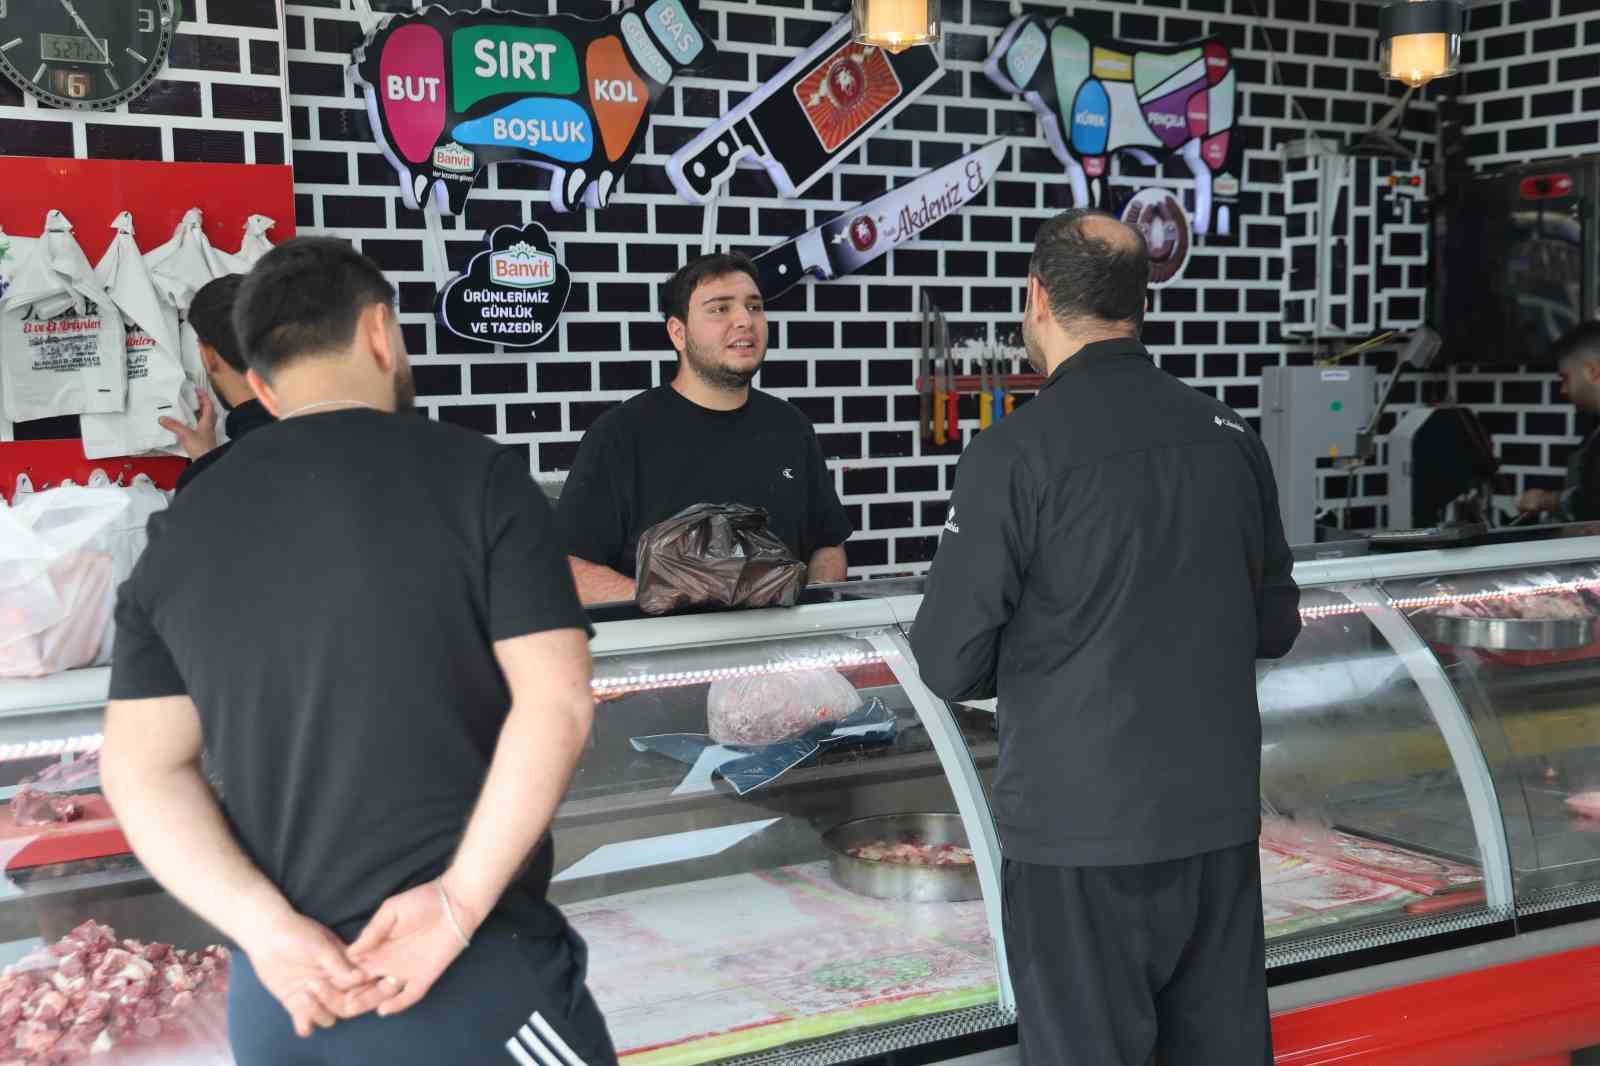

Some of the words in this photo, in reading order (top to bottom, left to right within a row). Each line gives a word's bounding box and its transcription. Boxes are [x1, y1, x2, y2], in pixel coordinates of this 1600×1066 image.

[137, 8, 155, 33] 3
[474, 39, 557, 80] SIRT
[67, 73, 87, 97] 6
[387, 75, 440, 102] BUT
[594, 79, 638, 103] KOL
[492, 118, 586, 147] BOŞLUK
[437, 151, 471, 167] Banvit
[893, 181, 963, 242] Akdeniz
[965, 160, 984, 193] Et
[496, 259, 550, 278] Banvit
[463, 288, 549, 304] ÜRÜNLERİMİZ
[481, 305, 533, 319] GÜNLÜK
[471, 321, 488, 334] VE
[491, 320, 543, 334] TAZEDİR
